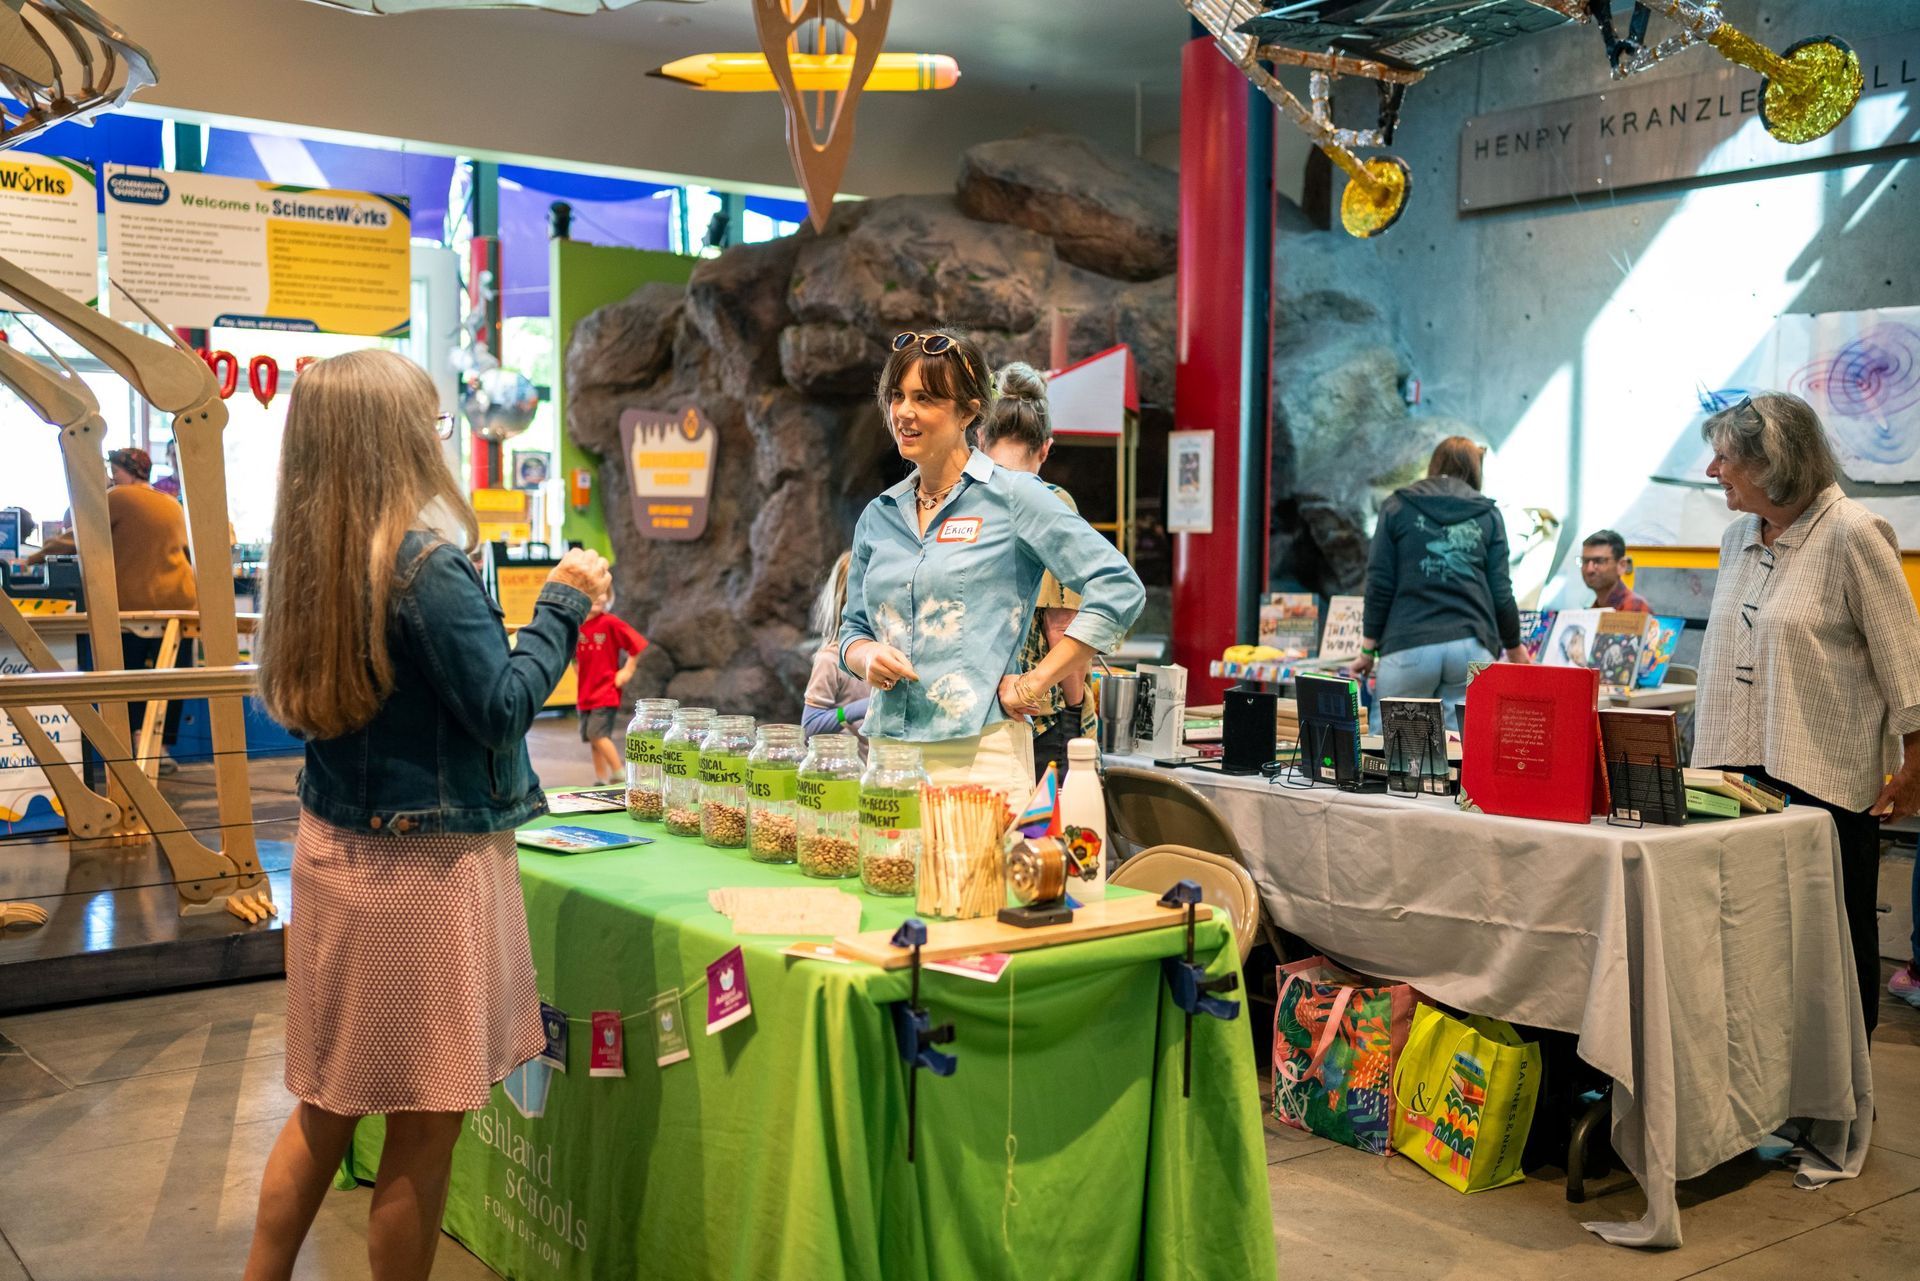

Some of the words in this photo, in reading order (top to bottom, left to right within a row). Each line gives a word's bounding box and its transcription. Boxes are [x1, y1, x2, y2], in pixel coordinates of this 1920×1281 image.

[1474, 122, 1573, 160] HENRY
[1600, 88, 1757, 138] KRANZLE
[180, 194, 251, 212] Welcome
[256, 202, 269, 213] to
[470, 1107, 552, 1189] Ashland
